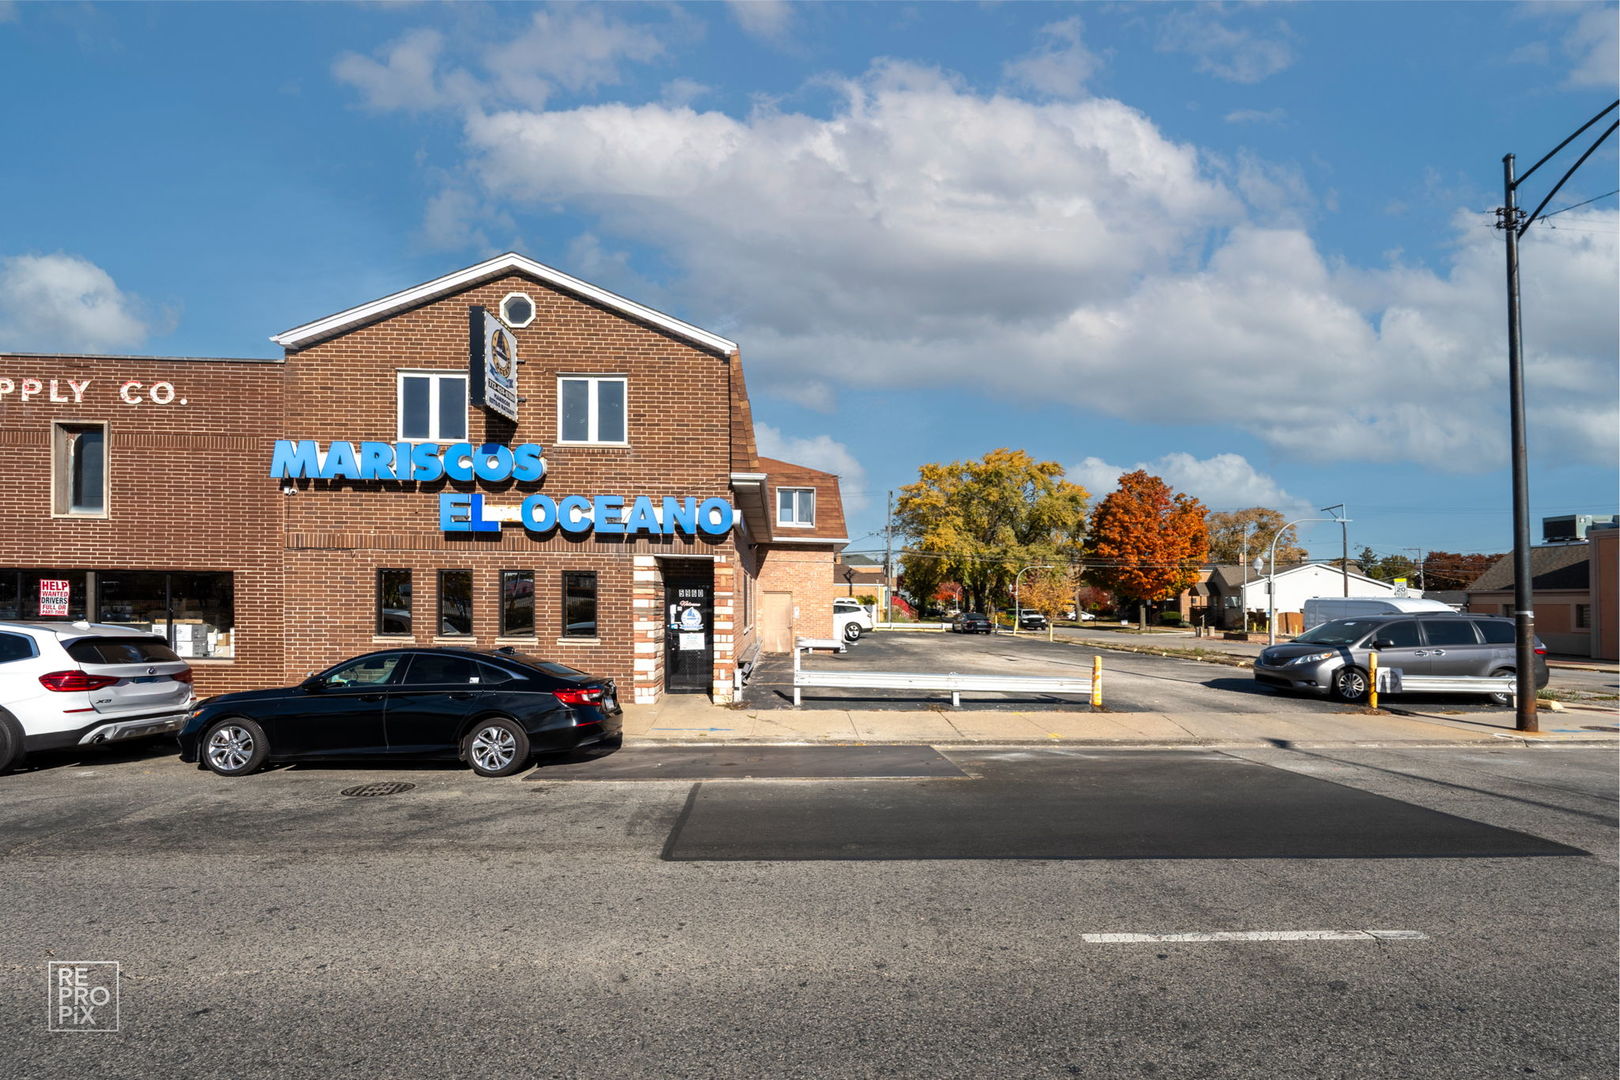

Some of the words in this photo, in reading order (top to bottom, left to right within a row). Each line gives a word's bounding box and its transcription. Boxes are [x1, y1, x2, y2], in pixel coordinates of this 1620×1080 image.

[0, 377, 93, 403] PPLY
[119, 380, 188, 405] CO.
[269, 440, 546, 482] MARISCOS
[439, 493, 501, 533] EL
[521, 494, 734, 535] OCEANO
[42, 581, 68, 591] HELP
